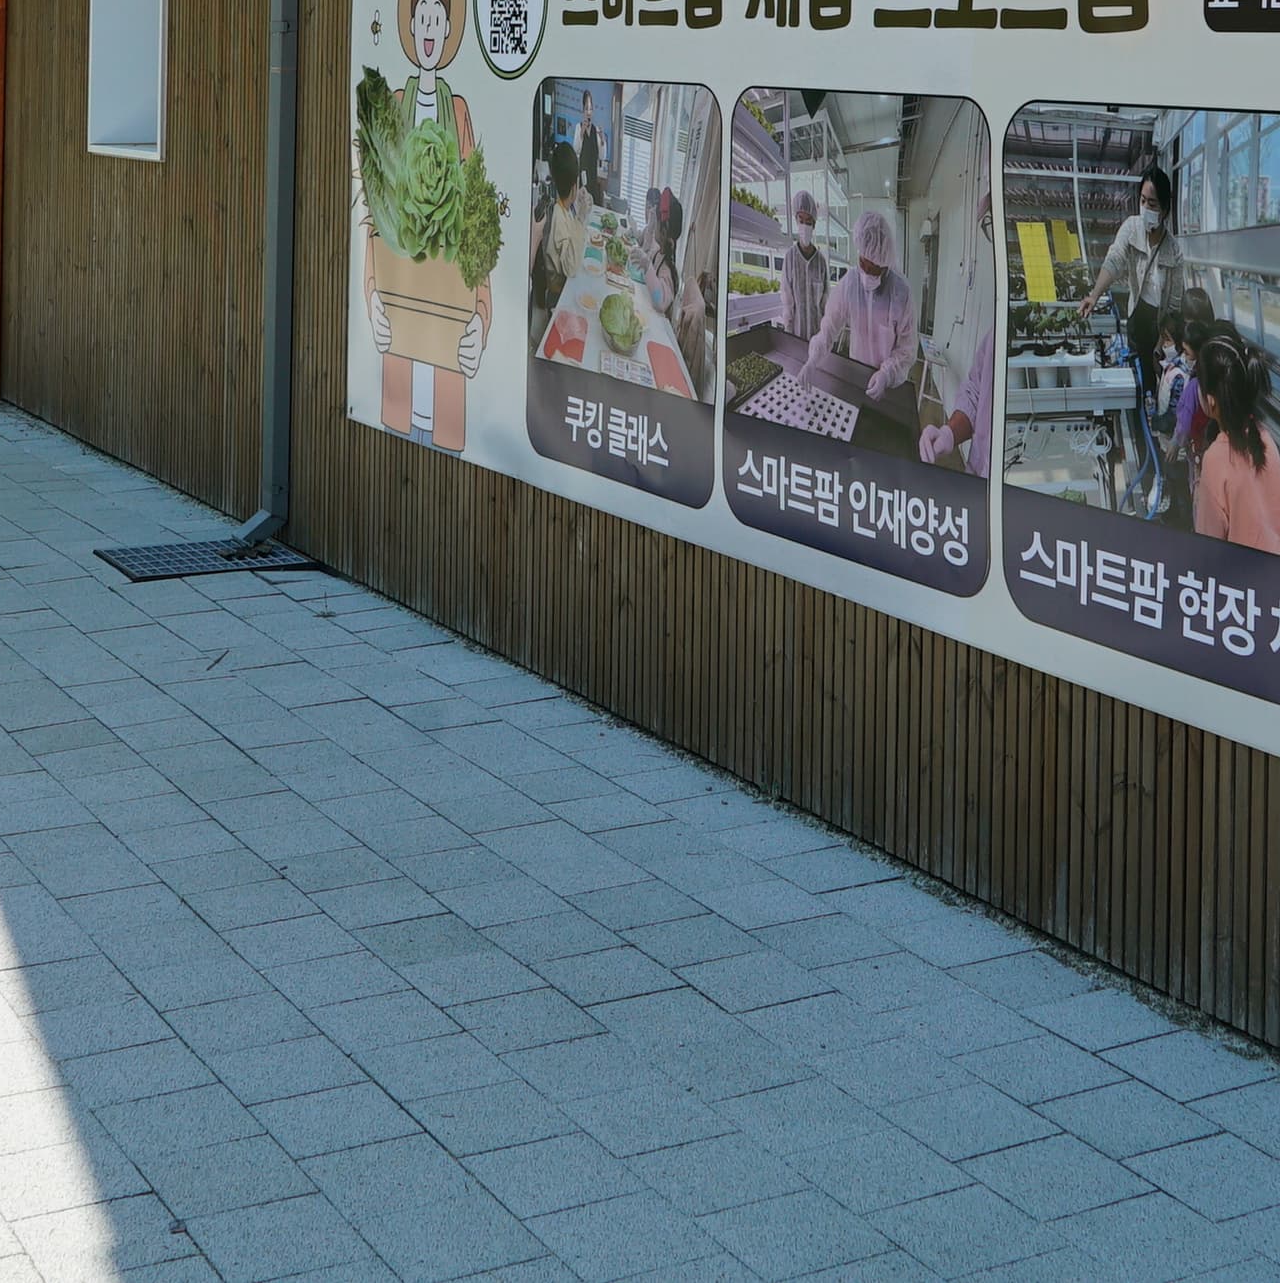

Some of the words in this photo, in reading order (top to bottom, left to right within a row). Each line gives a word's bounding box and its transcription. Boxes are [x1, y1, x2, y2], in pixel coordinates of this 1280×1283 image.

[564, 395, 603, 450] 쿠킹
[607, 406, 669, 467] 클래스
[736, 448, 844, 528] 스마트팜
[848, 480, 969, 567] 인재양성
[1020, 530, 1170, 630] 스마트팜
[1177, 569, 1261, 657] 현장
